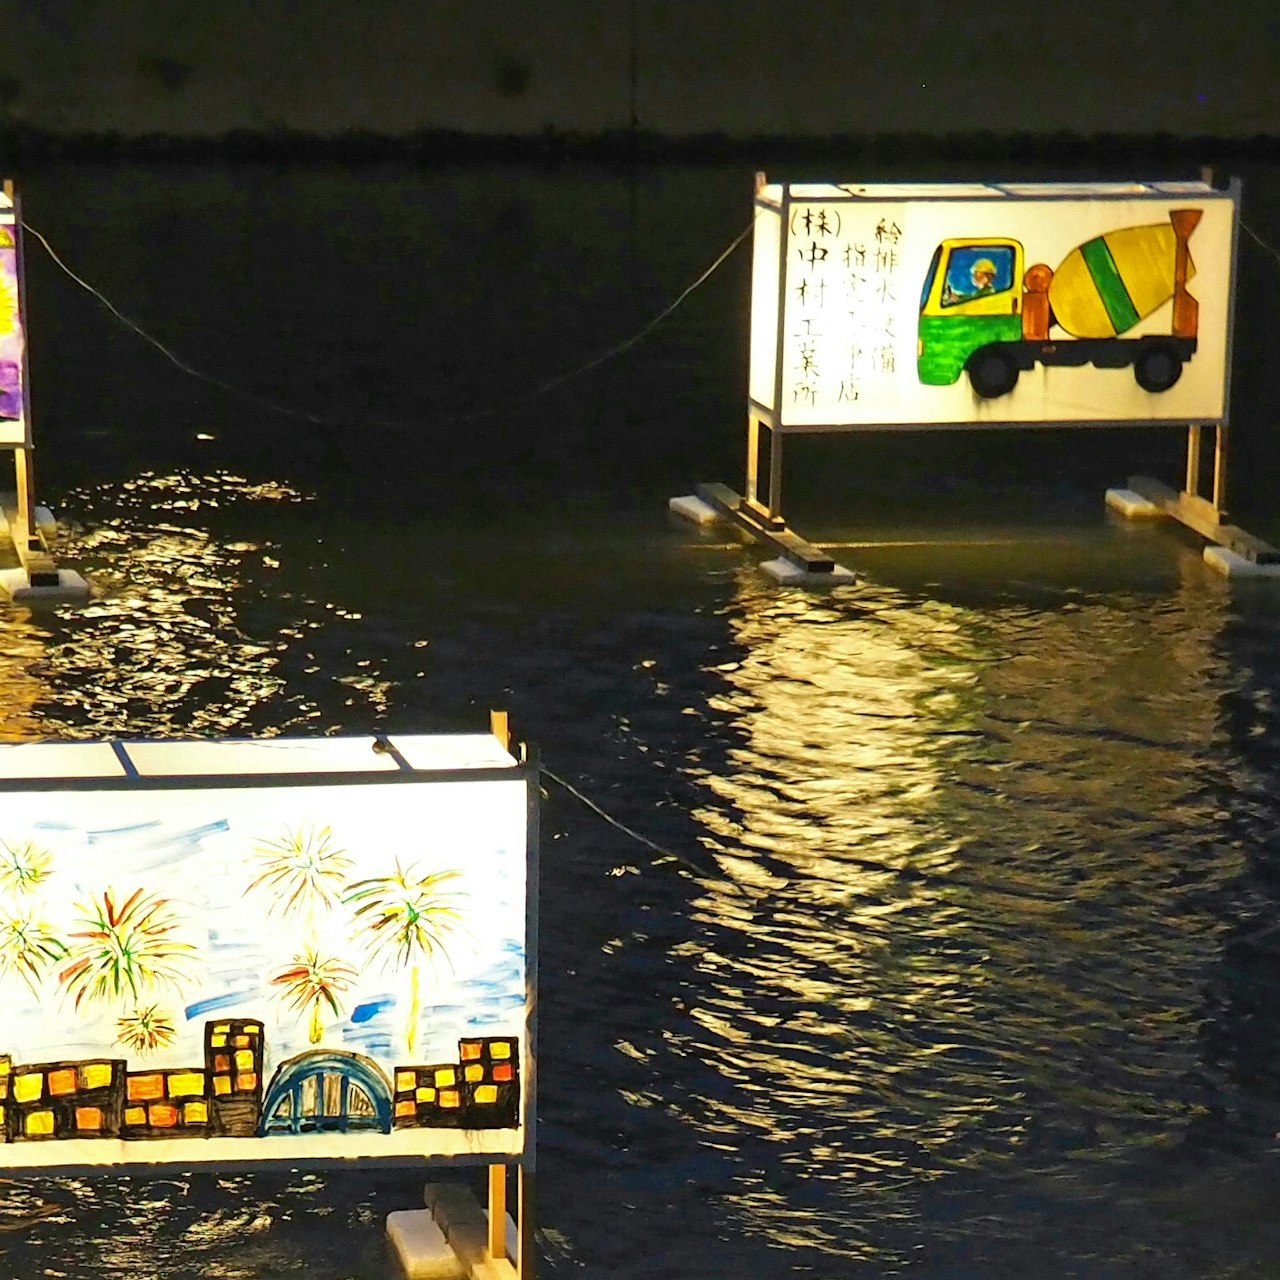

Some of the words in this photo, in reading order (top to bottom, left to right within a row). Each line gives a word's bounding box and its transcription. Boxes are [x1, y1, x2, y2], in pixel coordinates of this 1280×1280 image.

[791, 208, 841, 407] (株)中村工業所
